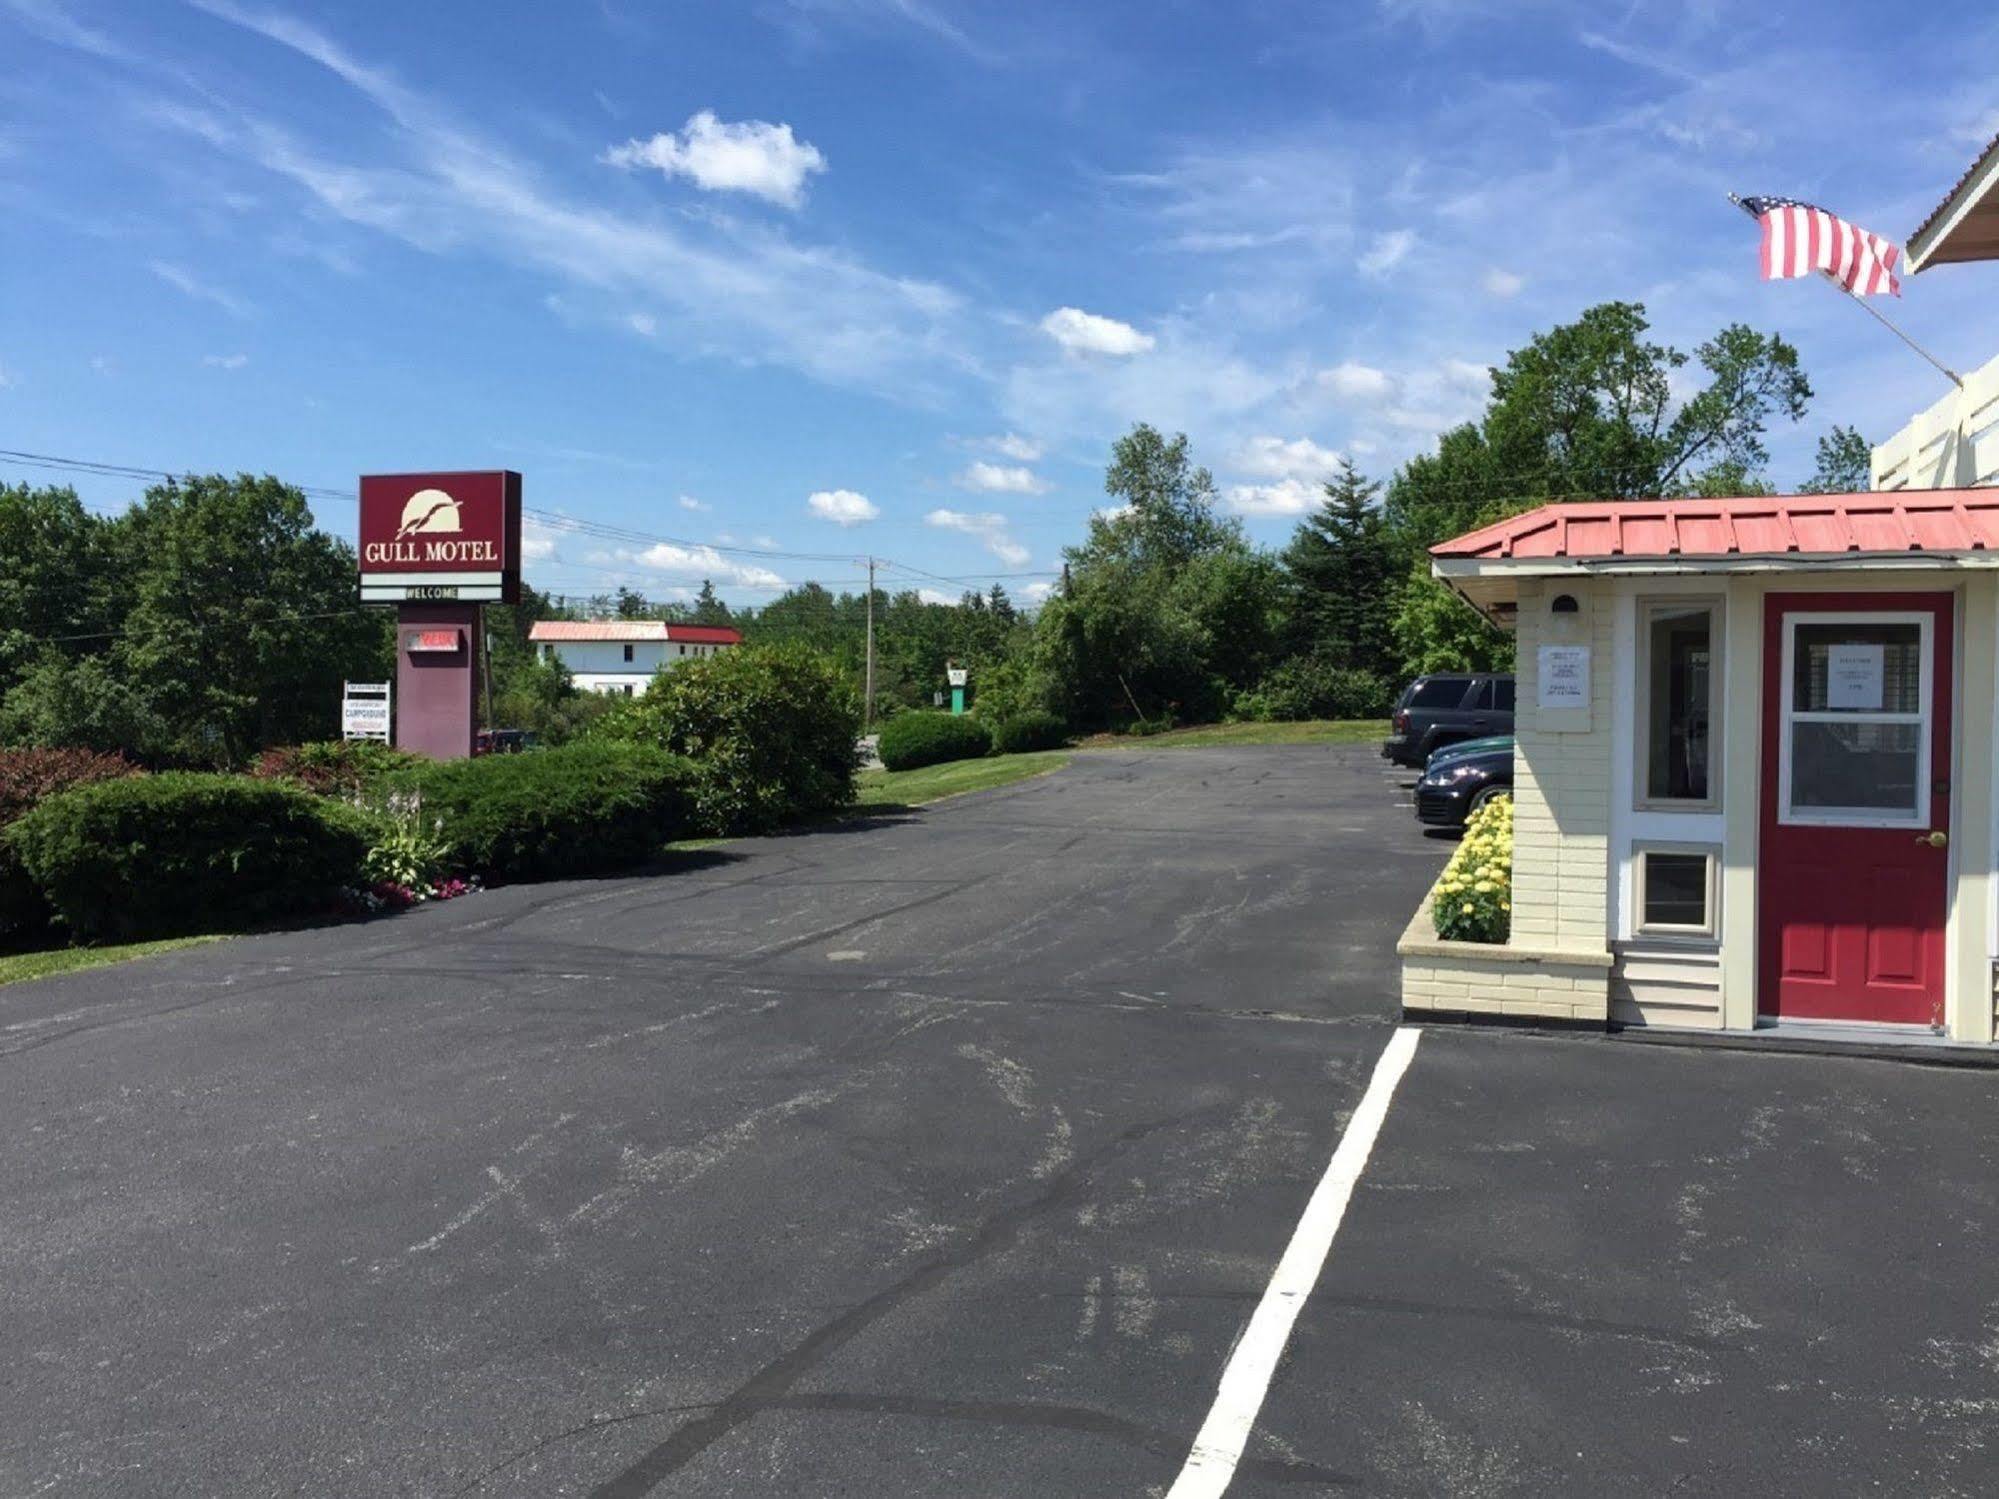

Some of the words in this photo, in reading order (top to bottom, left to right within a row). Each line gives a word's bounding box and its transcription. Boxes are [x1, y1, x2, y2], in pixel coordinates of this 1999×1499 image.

[365, 542, 420, 563] GULL
[425, 541, 498, 562] MOTEL
[407, 588, 458, 600] WELCOME
